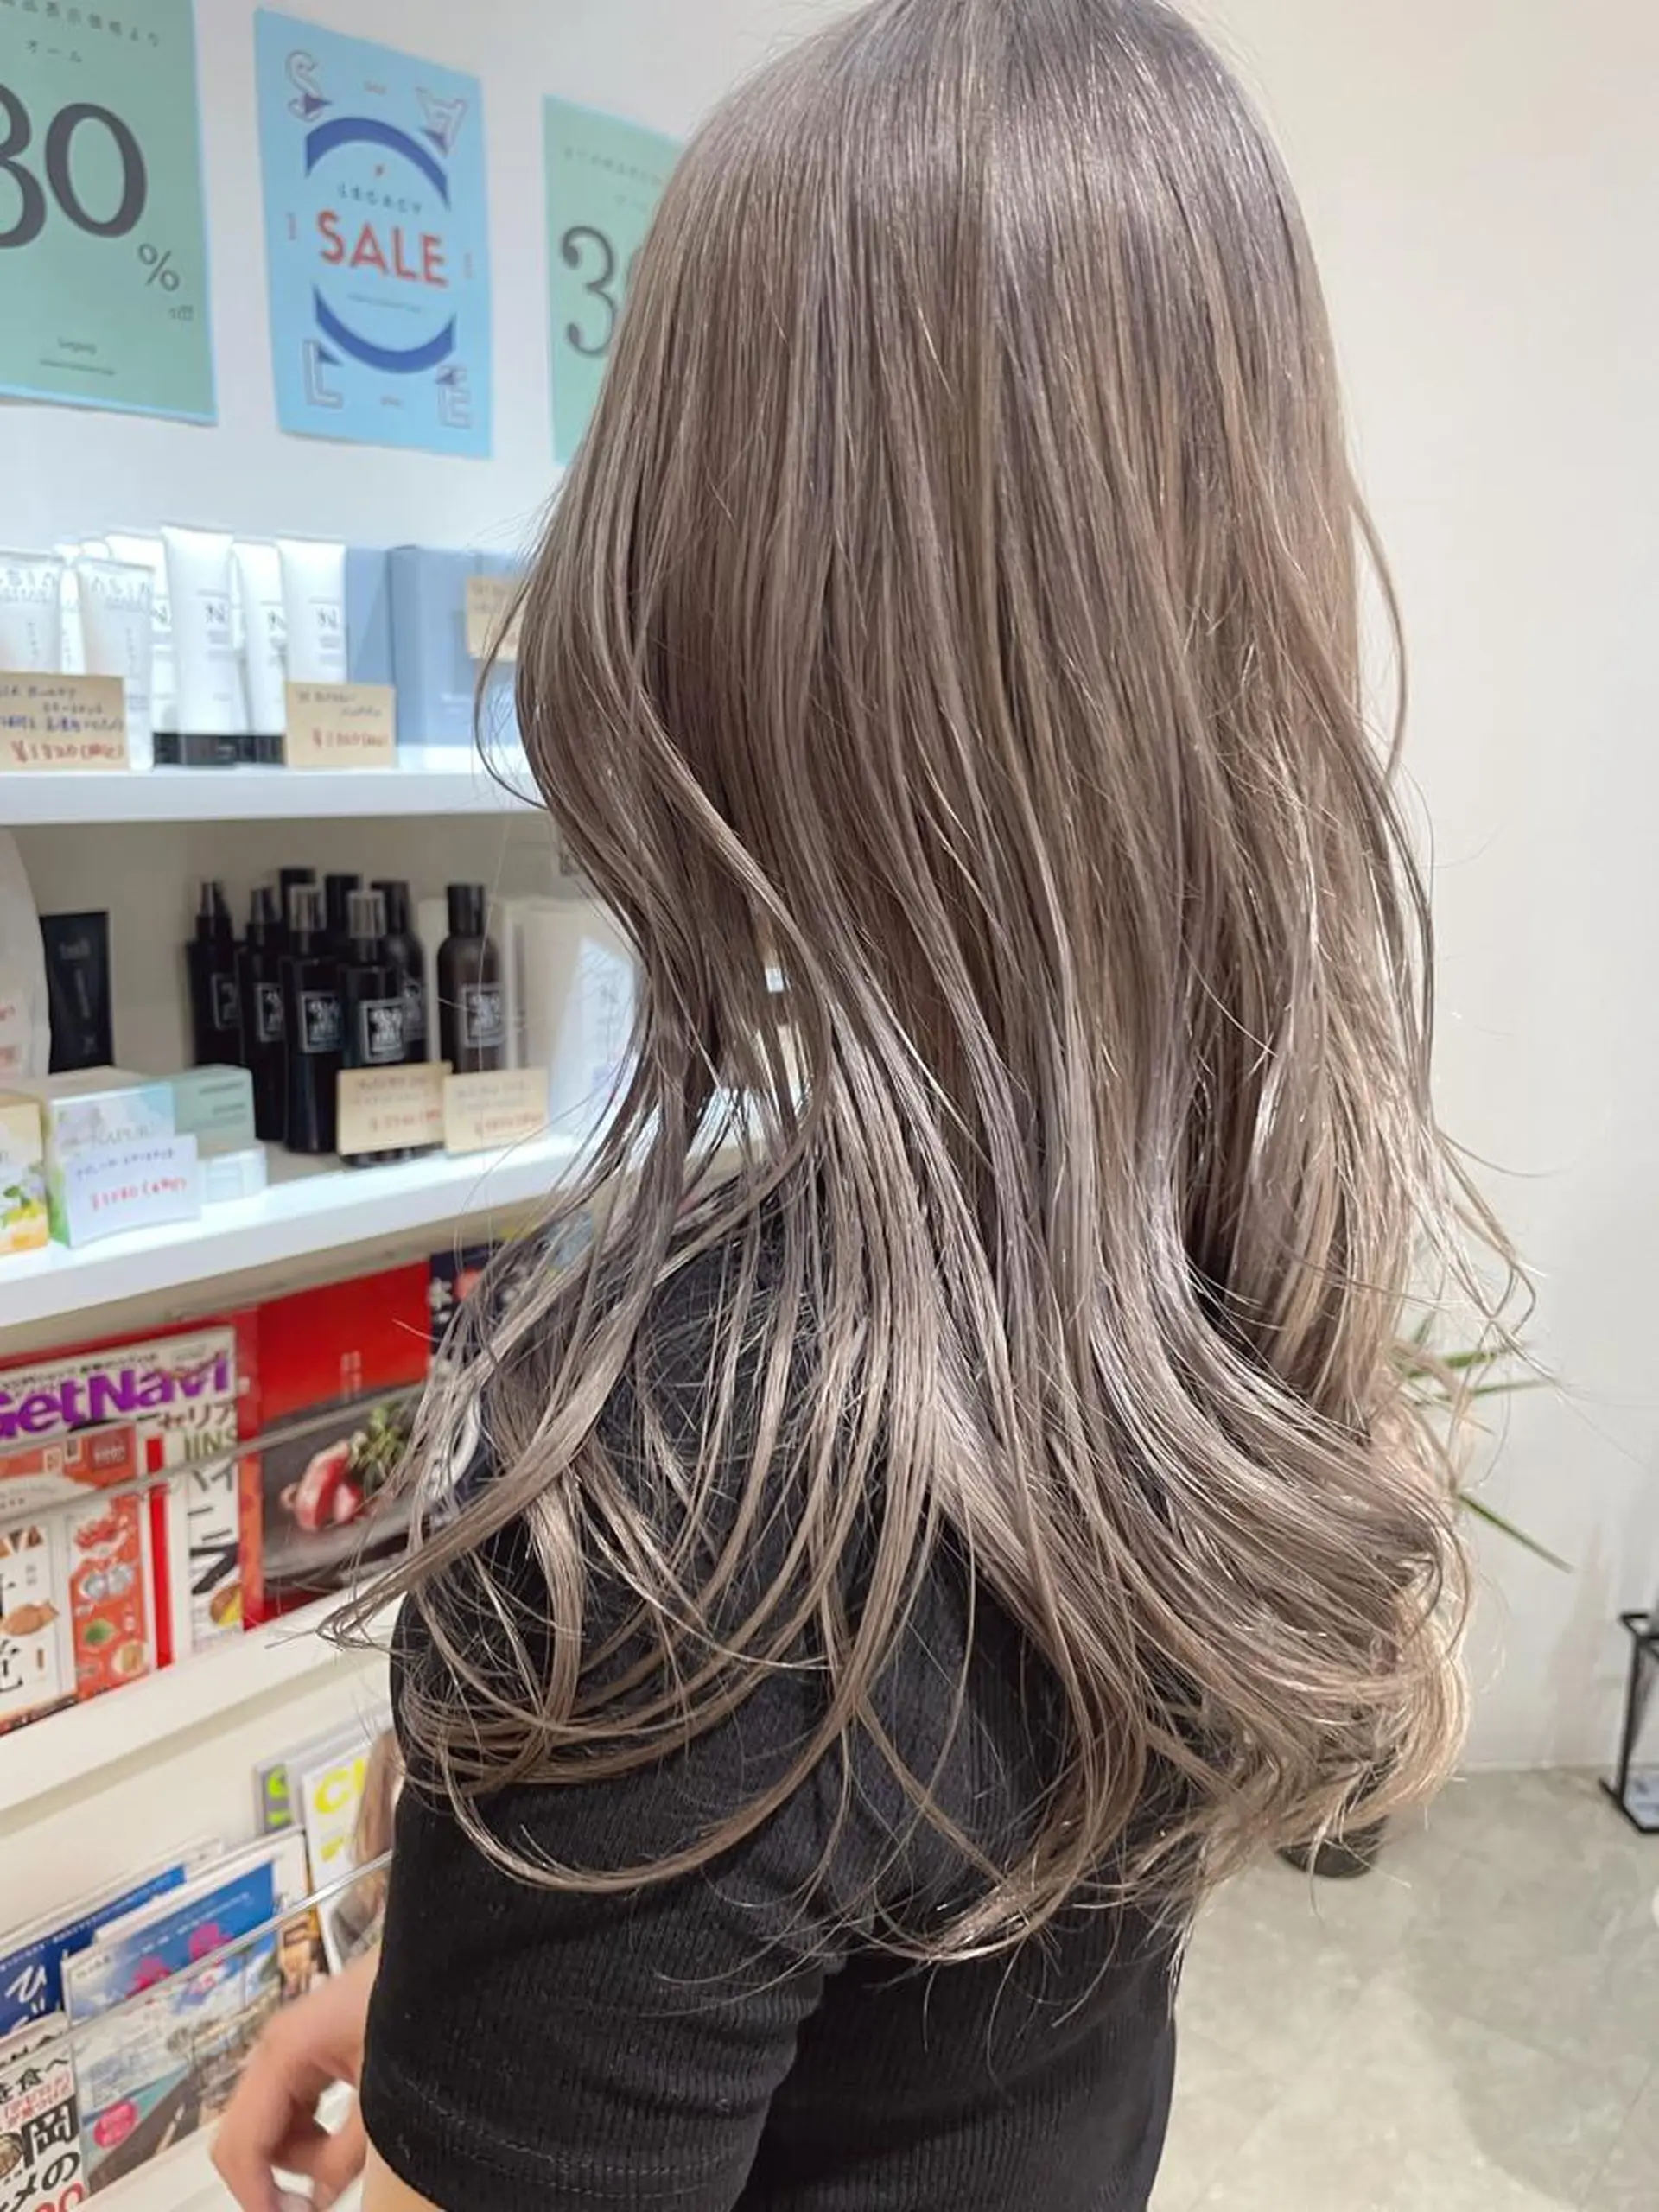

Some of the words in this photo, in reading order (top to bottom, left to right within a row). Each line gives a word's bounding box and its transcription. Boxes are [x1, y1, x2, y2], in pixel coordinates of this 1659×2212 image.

[138, 243, 180, 292] %
[316, 209, 449, 289] SALE
[561, 226, 633, 359] 3
